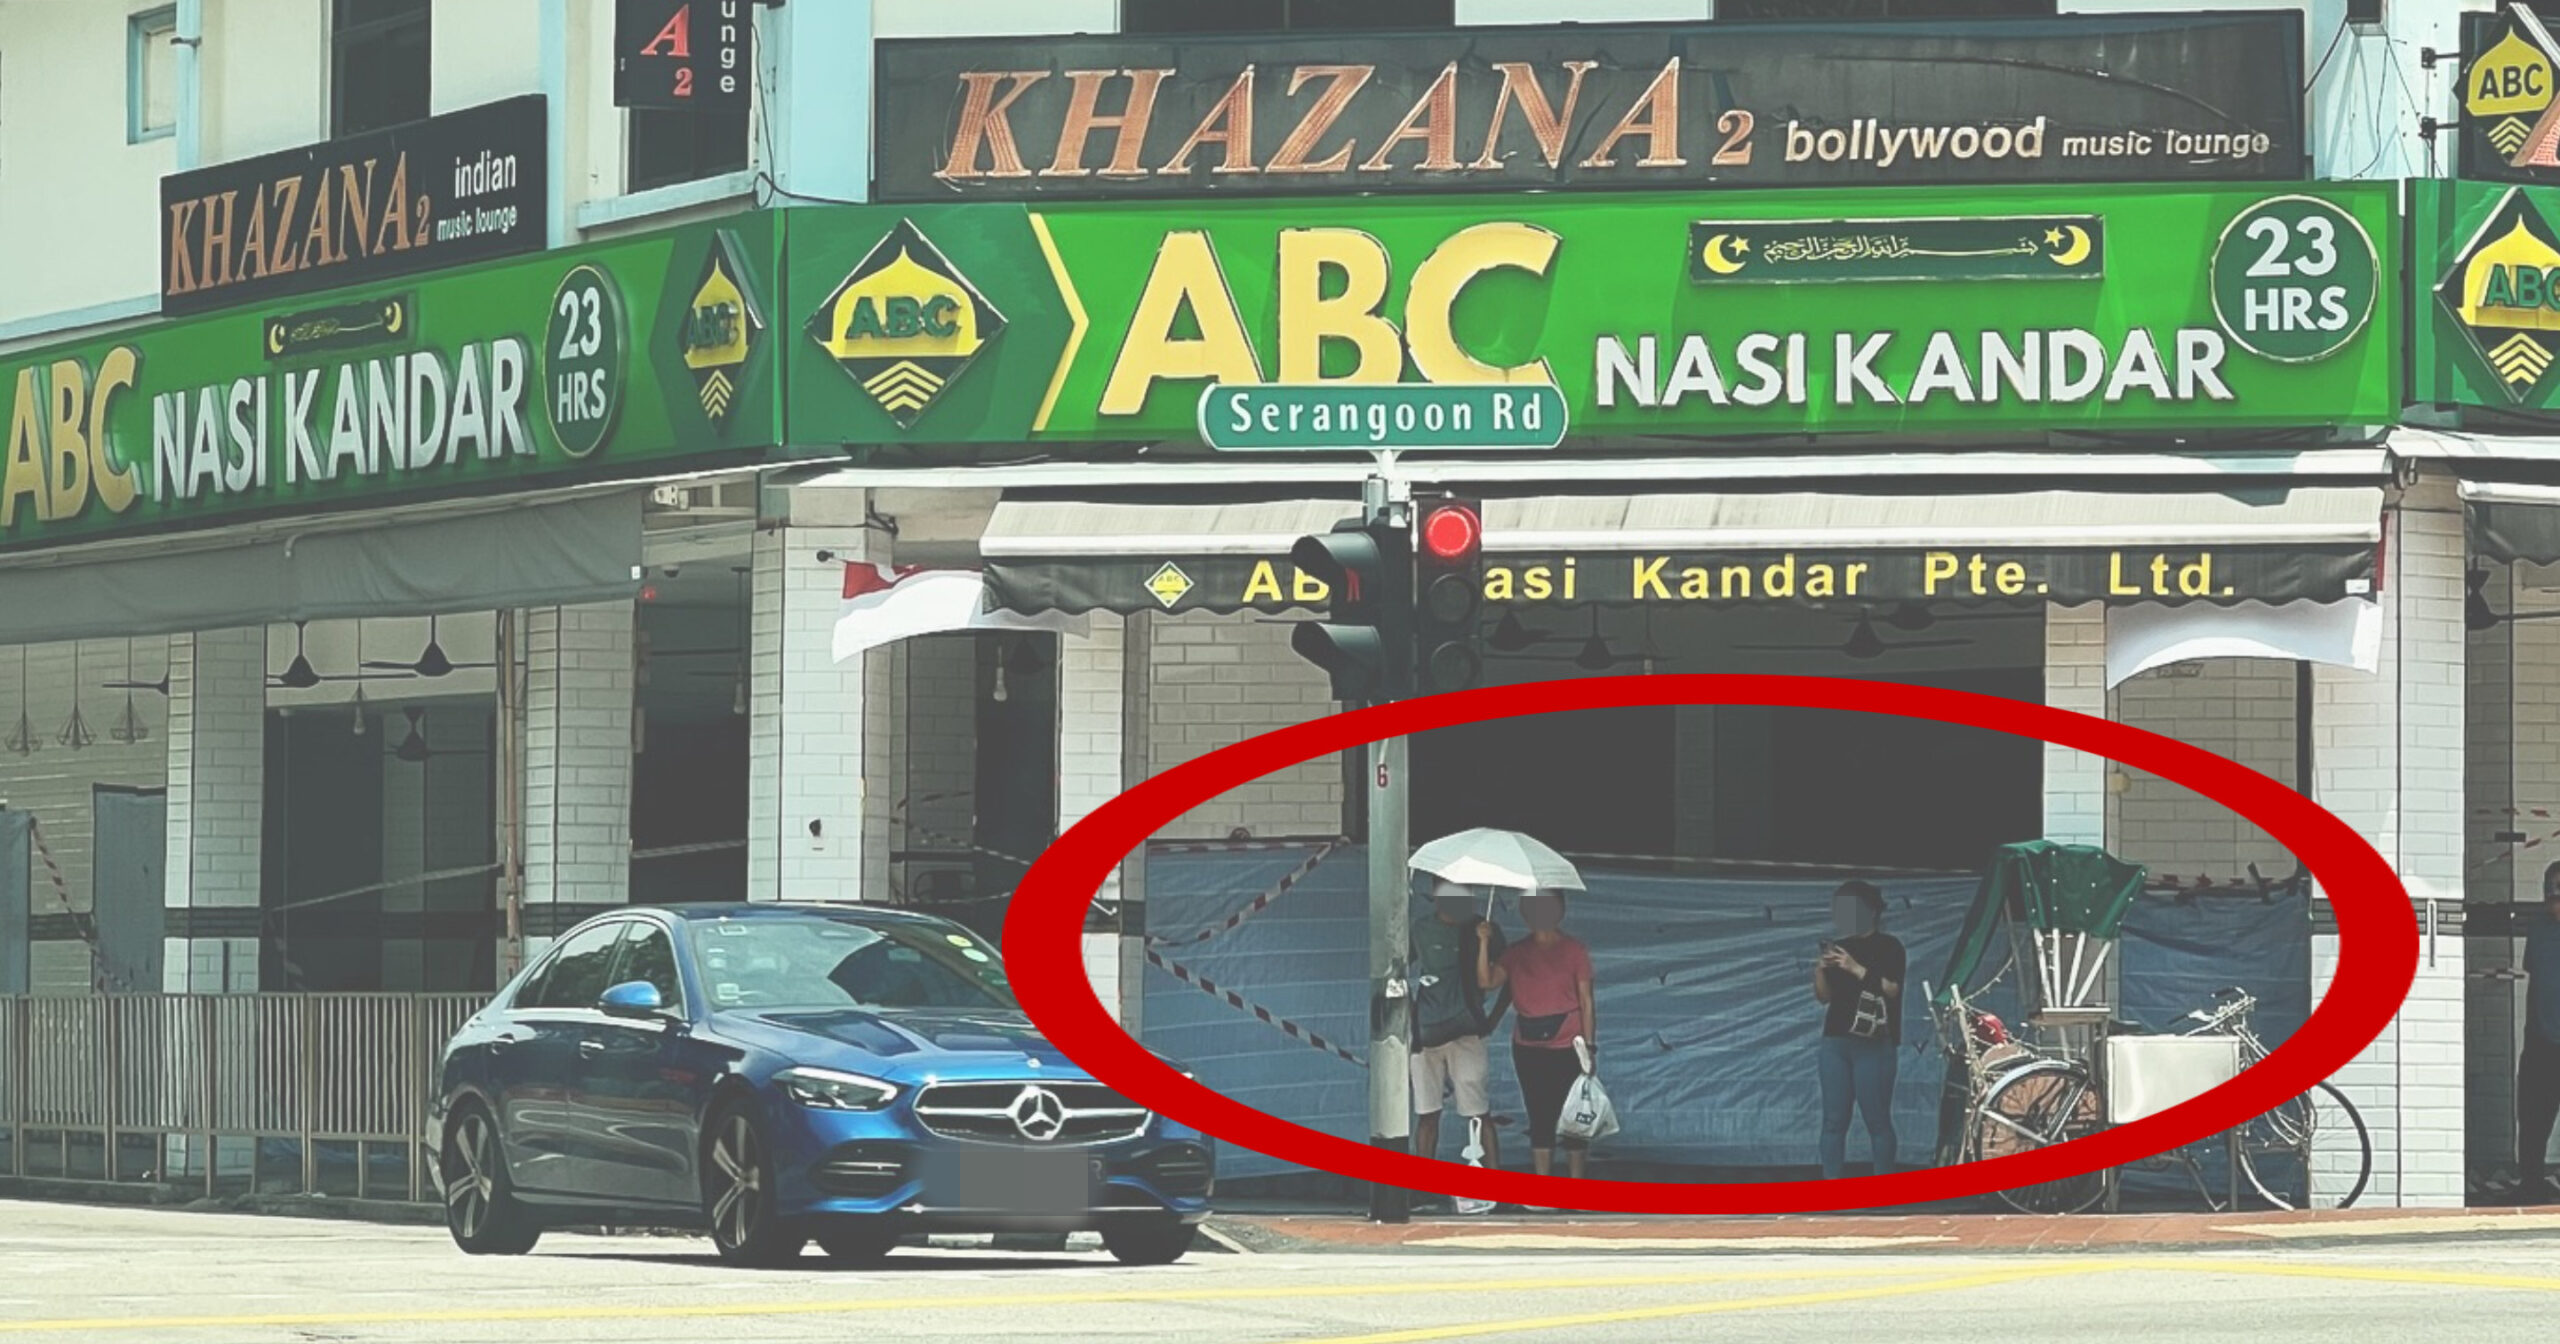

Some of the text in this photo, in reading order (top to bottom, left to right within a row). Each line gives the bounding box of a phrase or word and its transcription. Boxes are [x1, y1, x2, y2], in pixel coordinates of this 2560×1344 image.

[673, 66, 693, 96] 2
[2478, 63, 2544, 100] ABC
[932, 57, 2270, 180] KHAZANA 2 bollywood music lounge
[455, 149, 517, 199] indian
[166, 150, 431, 296] KHAZANA 2
[437, 205, 517, 241] music lounge
[2246, 215, 2338, 277] 23
[559, 286, 602, 360] 23
[845, 294, 961, 340] ABC
[1099, 221, 1563, 414] ABC
[2245, 287, 2350, 333] HRS
[1597, 328, 2236, 407] NASI KANDAR
[153, 337, 533, 501] NASI KANDAR
[557, 368, 606, 424] HRS
[1230, 392, 1542, 441] Serangoon Rd
[1, 346, 138, 527] ABC
[1242, 551, 2237, 603] AB asi Kandar Pte. Ltd.
[1377, 763, 1389, 789] 6
